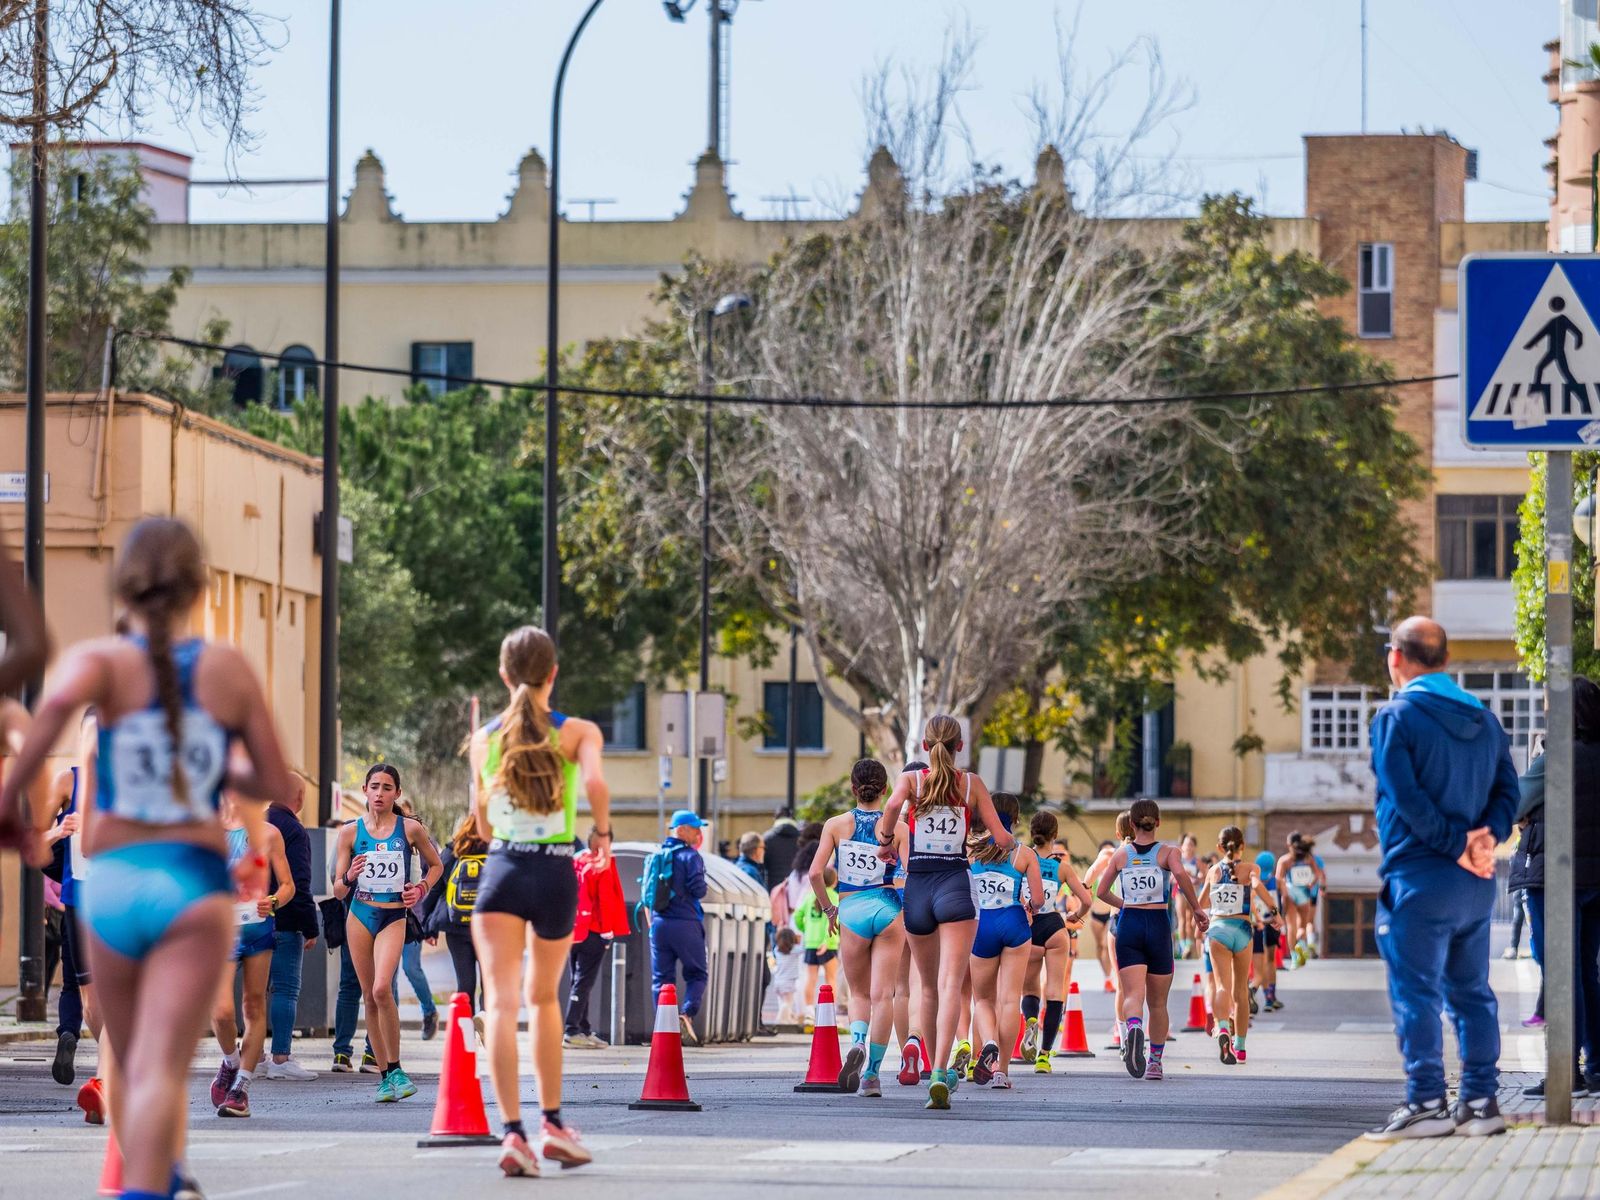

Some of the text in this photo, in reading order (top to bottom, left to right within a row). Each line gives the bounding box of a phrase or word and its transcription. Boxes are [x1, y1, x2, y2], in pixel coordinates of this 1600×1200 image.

[127, 743, 212, 786] 39
[924, 816, 957, 835] 342
[846, 852, 877, 871] 353
[365, 862, 399, 879] 329
[979, 880, 1006, 894] 356
[1130, 876, 1156, 891] 350
[1024, 886, 1051, 900] 36
[1216, 891, 1237, 903] 325
